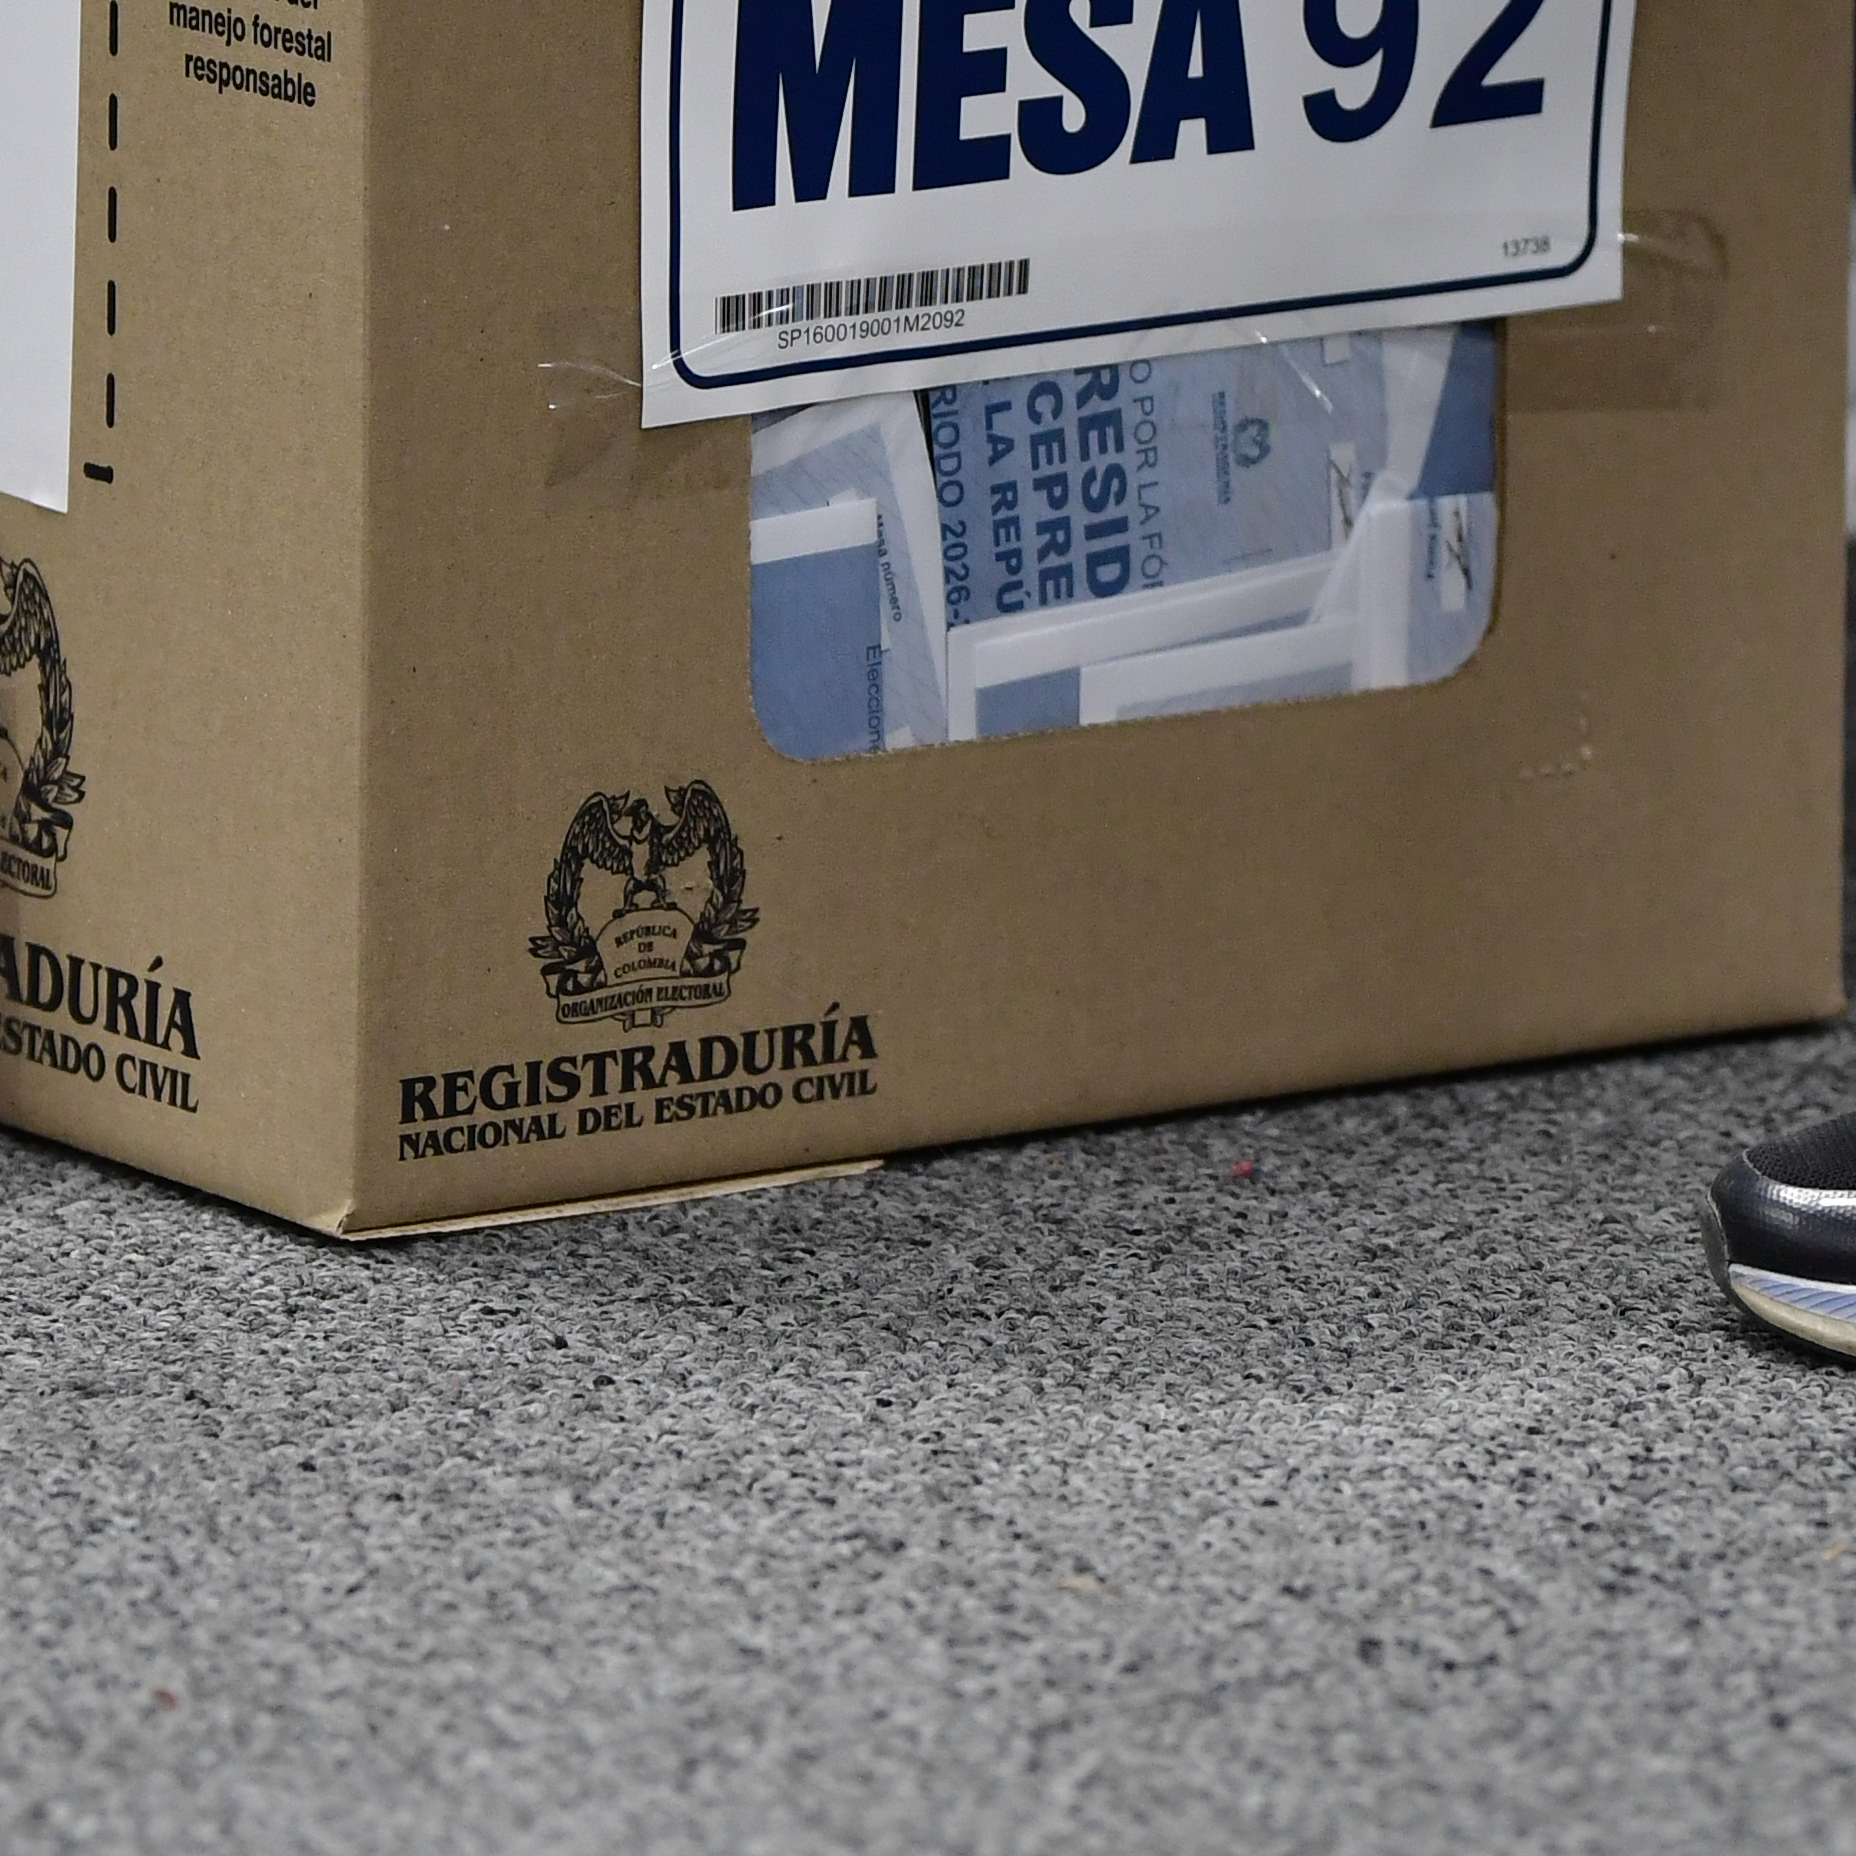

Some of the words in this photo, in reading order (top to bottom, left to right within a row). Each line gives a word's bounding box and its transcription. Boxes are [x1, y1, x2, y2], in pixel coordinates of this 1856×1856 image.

[169, 1, 245, 47] manejo
[252, 14, 331, 62] forestal
[185, 53, 316, 107] responsable
[777, 309, 965, 349] SP160019001M2092
[984, 400, 1015, 467] LA
[1132, 395, 1158, 472] POR
[1137, 481, 1161, 525] LA
[990, 479, 1031, 614] REPÚ
[881, 562, 902, 622] número
[614, 925, 677, 948] REPÚBLICA
[638, 941, 653, 953] DE
[614, 957, 677, 978] COLOMBIA
[561, 984, 653, 1018] ORGANIZACIÓN
[656, 982, 725, 1001] ELECTORAL
[116, 1054, 200, 1114] CIVIL
[399, 1002, 878, 1125] REGISTRADURÍA
[398, 1110, 566, 1160] NACIONAL
[577, 1102, 643, 1135] DEL
[654, 1082, 782, 1125] ESTADO
[792, 1069, 878, 1105] CIVIL
